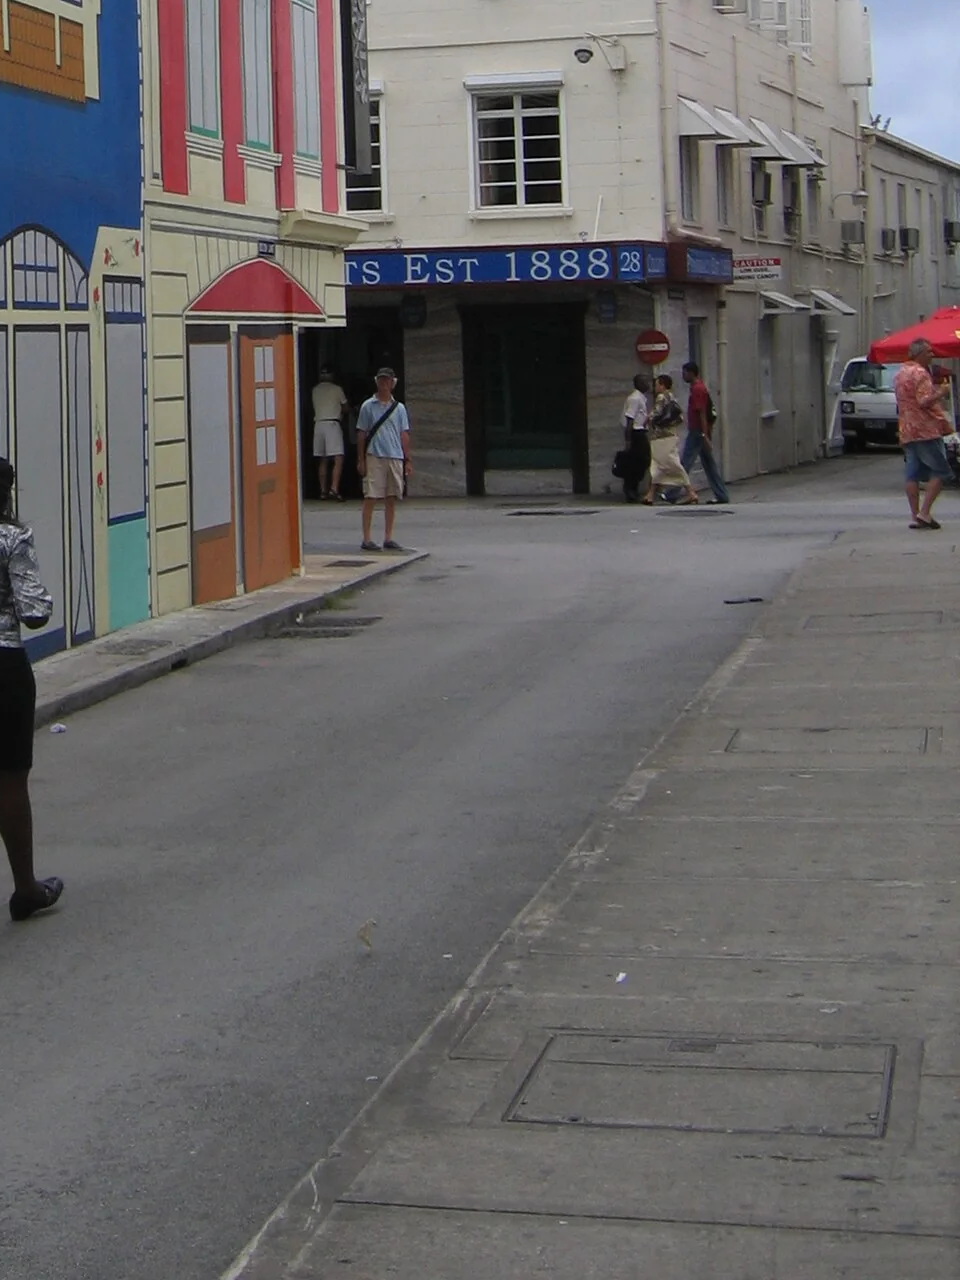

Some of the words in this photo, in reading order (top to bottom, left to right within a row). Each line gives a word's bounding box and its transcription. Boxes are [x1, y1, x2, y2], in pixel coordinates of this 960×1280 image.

[403, 254, 479, 284] EST
[505, 248, 610, 282] 1888
[620, 251, 641, 272] 28
[734, 259, 775, 267] CAUTION
